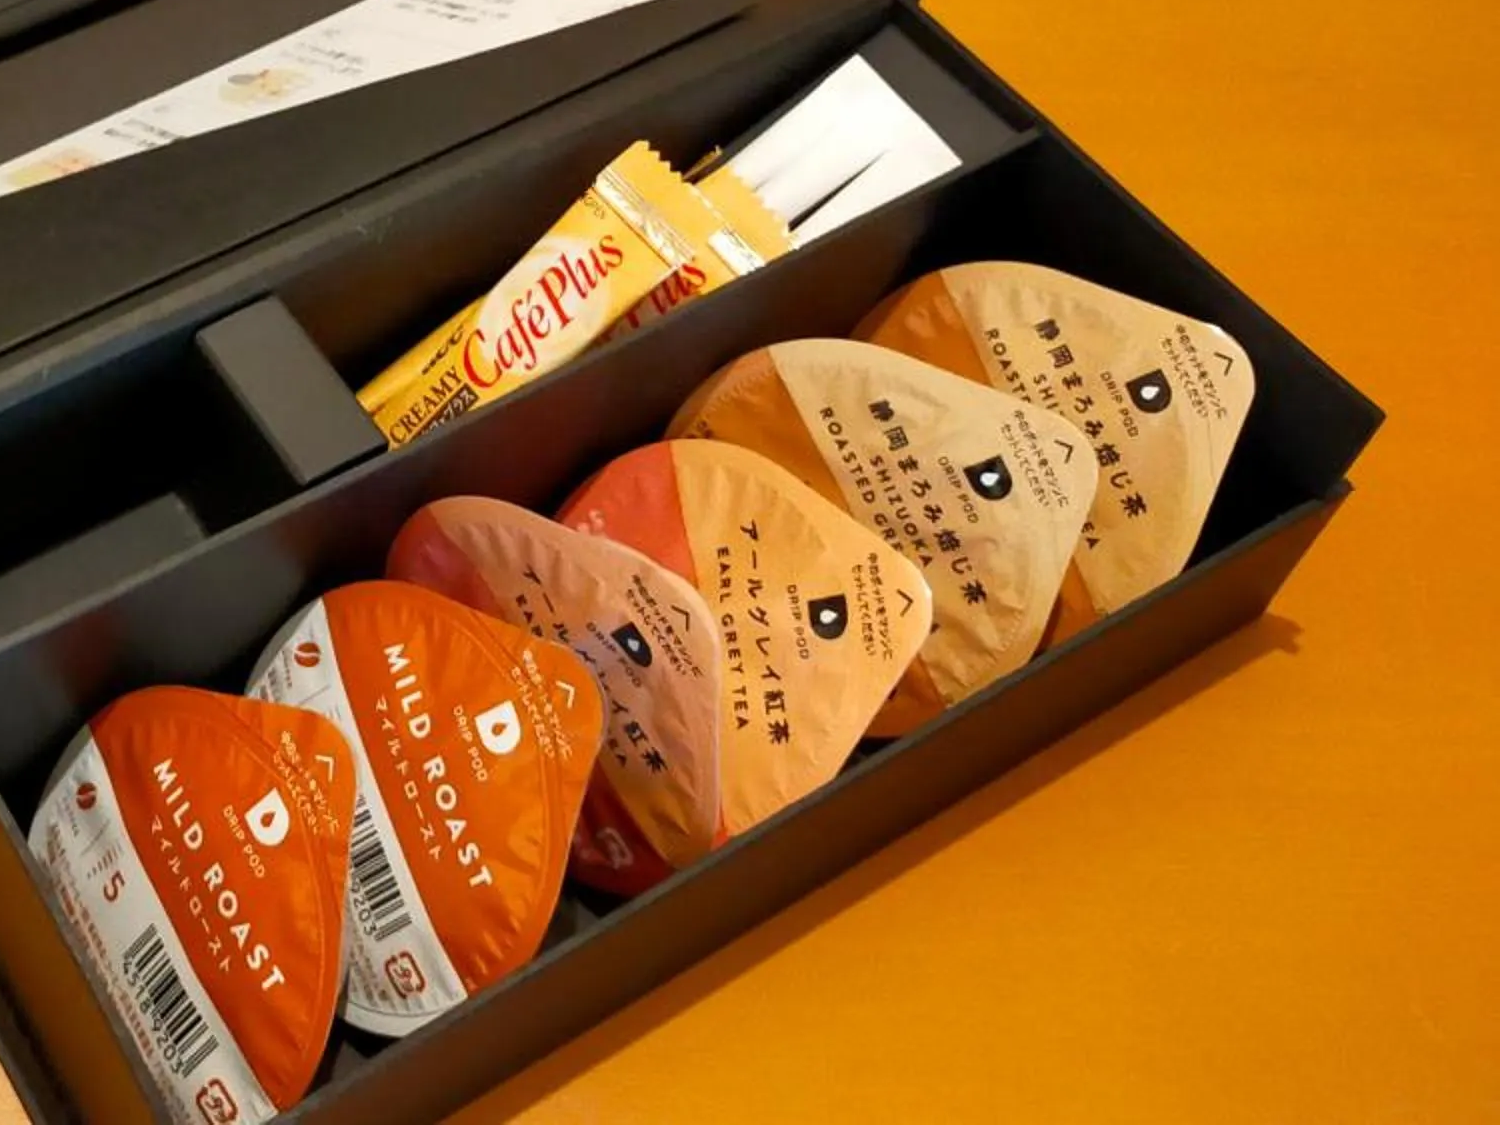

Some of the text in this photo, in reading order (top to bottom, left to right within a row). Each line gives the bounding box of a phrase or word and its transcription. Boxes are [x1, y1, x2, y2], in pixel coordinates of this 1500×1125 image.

[389, 366, 463, 443] CREAMY
[1034, 318, 1146, 518] 静岡まろみ焙じ茶
[1101, 371, 1139, 438] DRIP POD
[819, 406, 875, 504] ROASTED
[938, 456, 980, 524] DRIP POD
[868, 399, 987, 605] 静岡まろみ焙じ茶
[870, 455, 933, 568] SHIZUOKA
[586, 621, 641, 688] DRIP POD
[716, 546, 749, 731] EARL GREY TEA
[740, 518, 790, 745] アールグレイ紅茶
[786, 584, 809, 660] DRIP POD
[383, 643, 493, 887] MILD ROAST
[453, 703, 488, 781] DRIP POD
[153, 758, 285, 991] MILD ROAST
[223, 804, 265, 879] DRIP POD
[103, 870, 125, 903] 5
